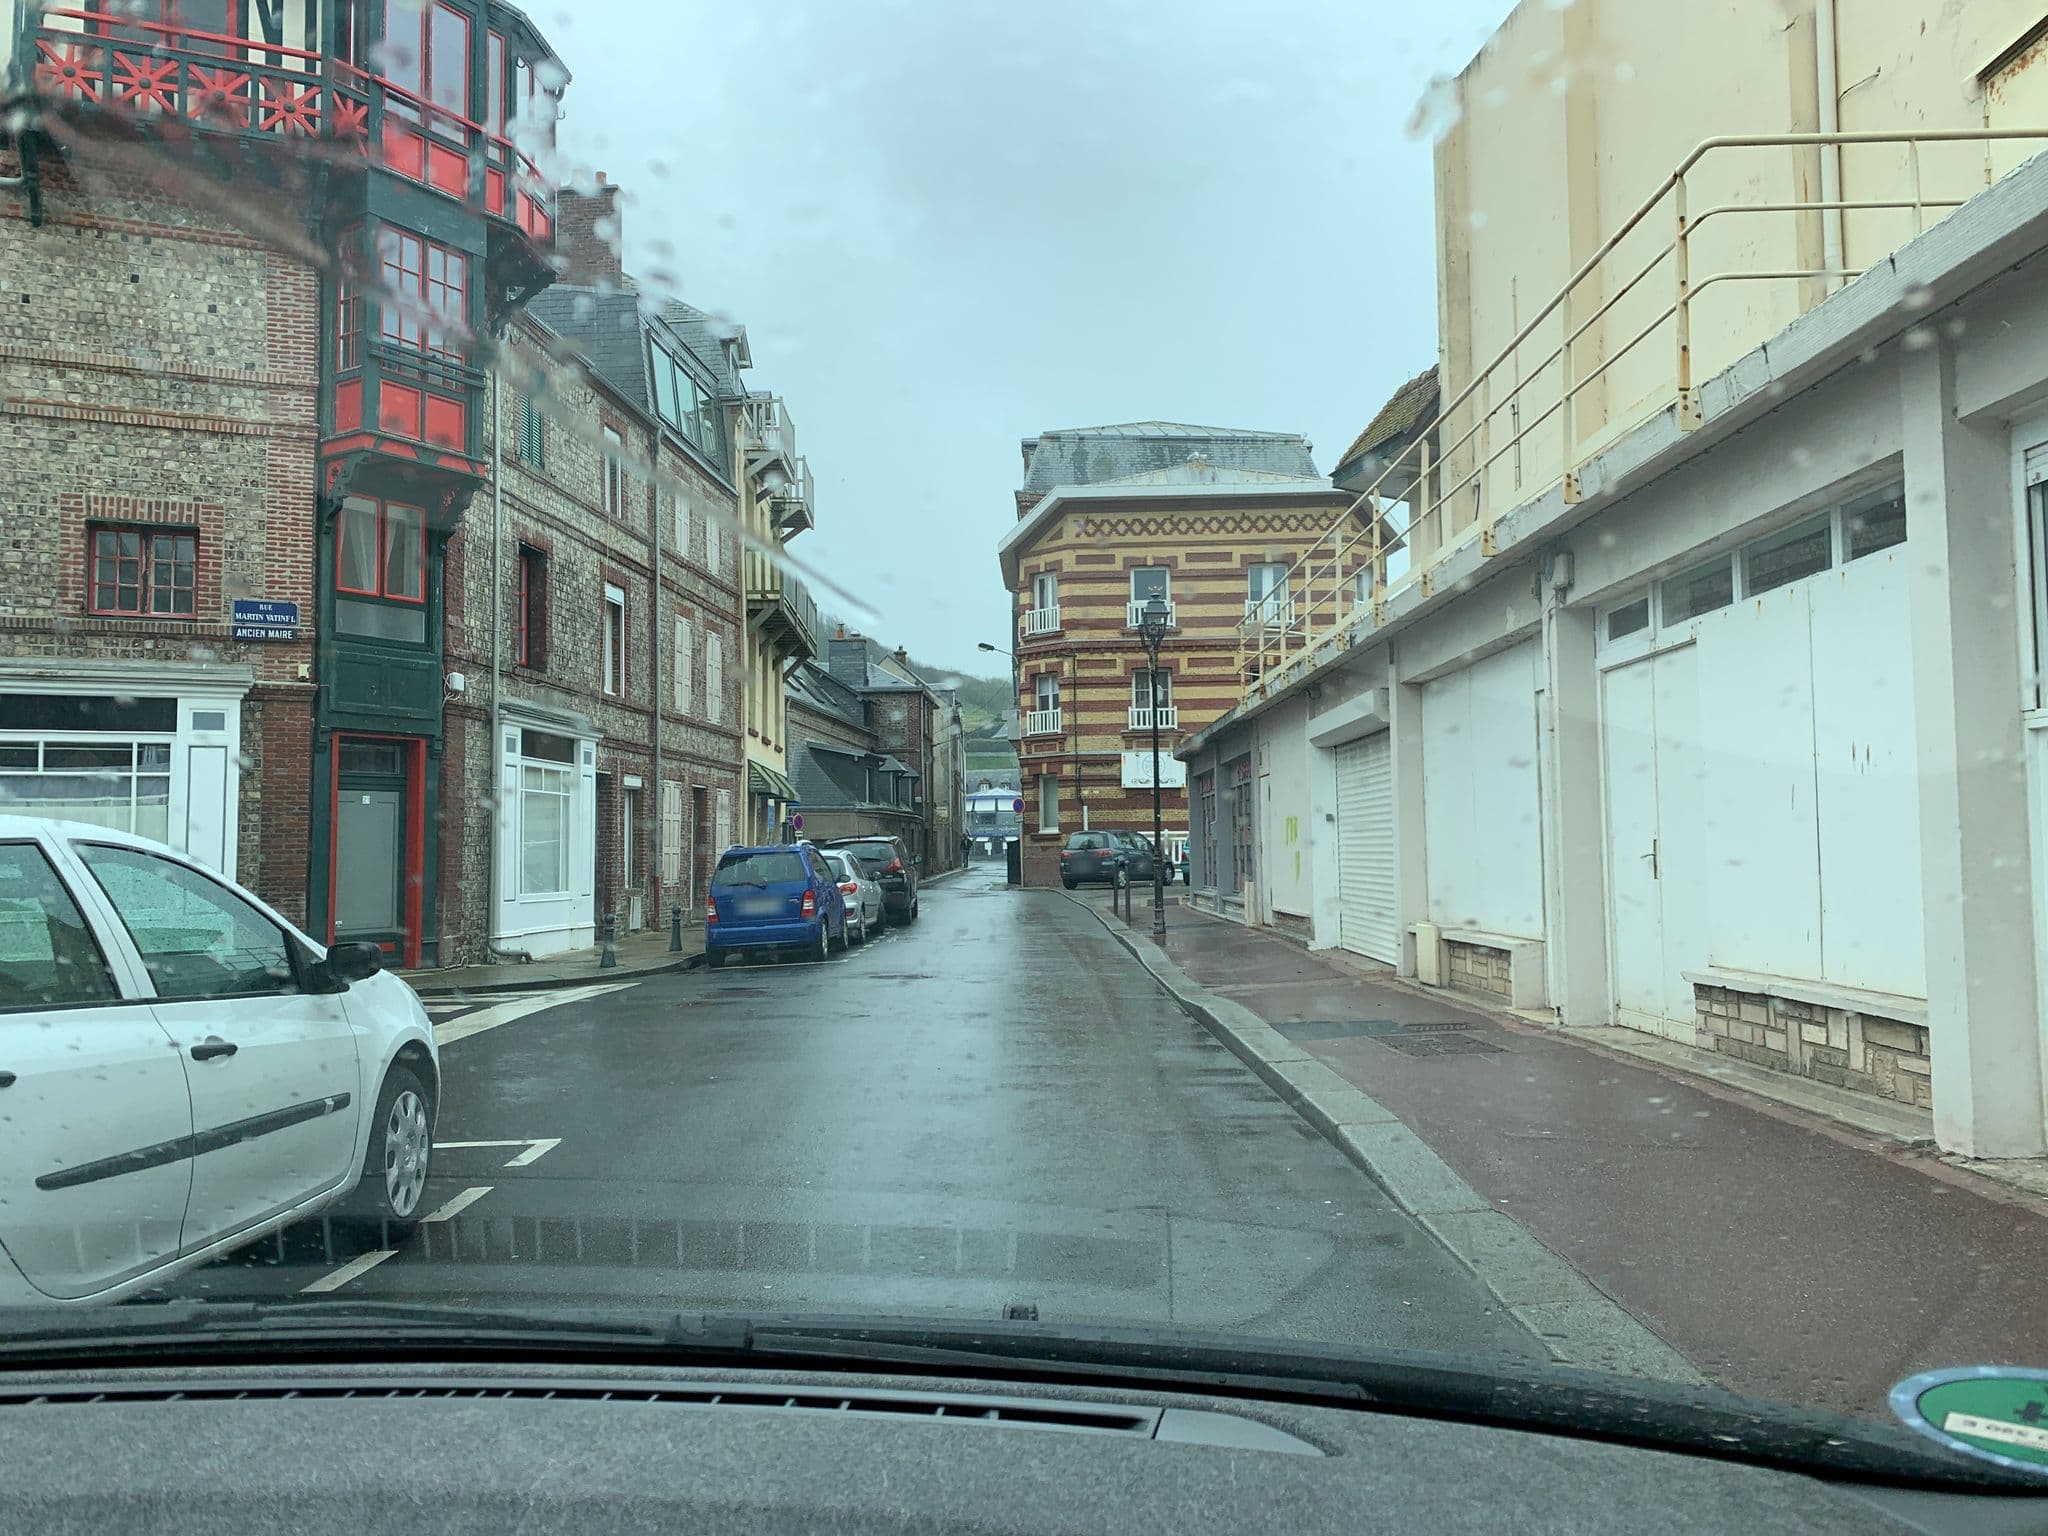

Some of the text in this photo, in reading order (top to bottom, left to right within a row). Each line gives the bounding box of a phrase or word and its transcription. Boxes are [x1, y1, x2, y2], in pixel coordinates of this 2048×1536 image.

[235, 612, 264, 620] MARTIN
[236, 628, 293, 639] ANCIEN MAIRE
